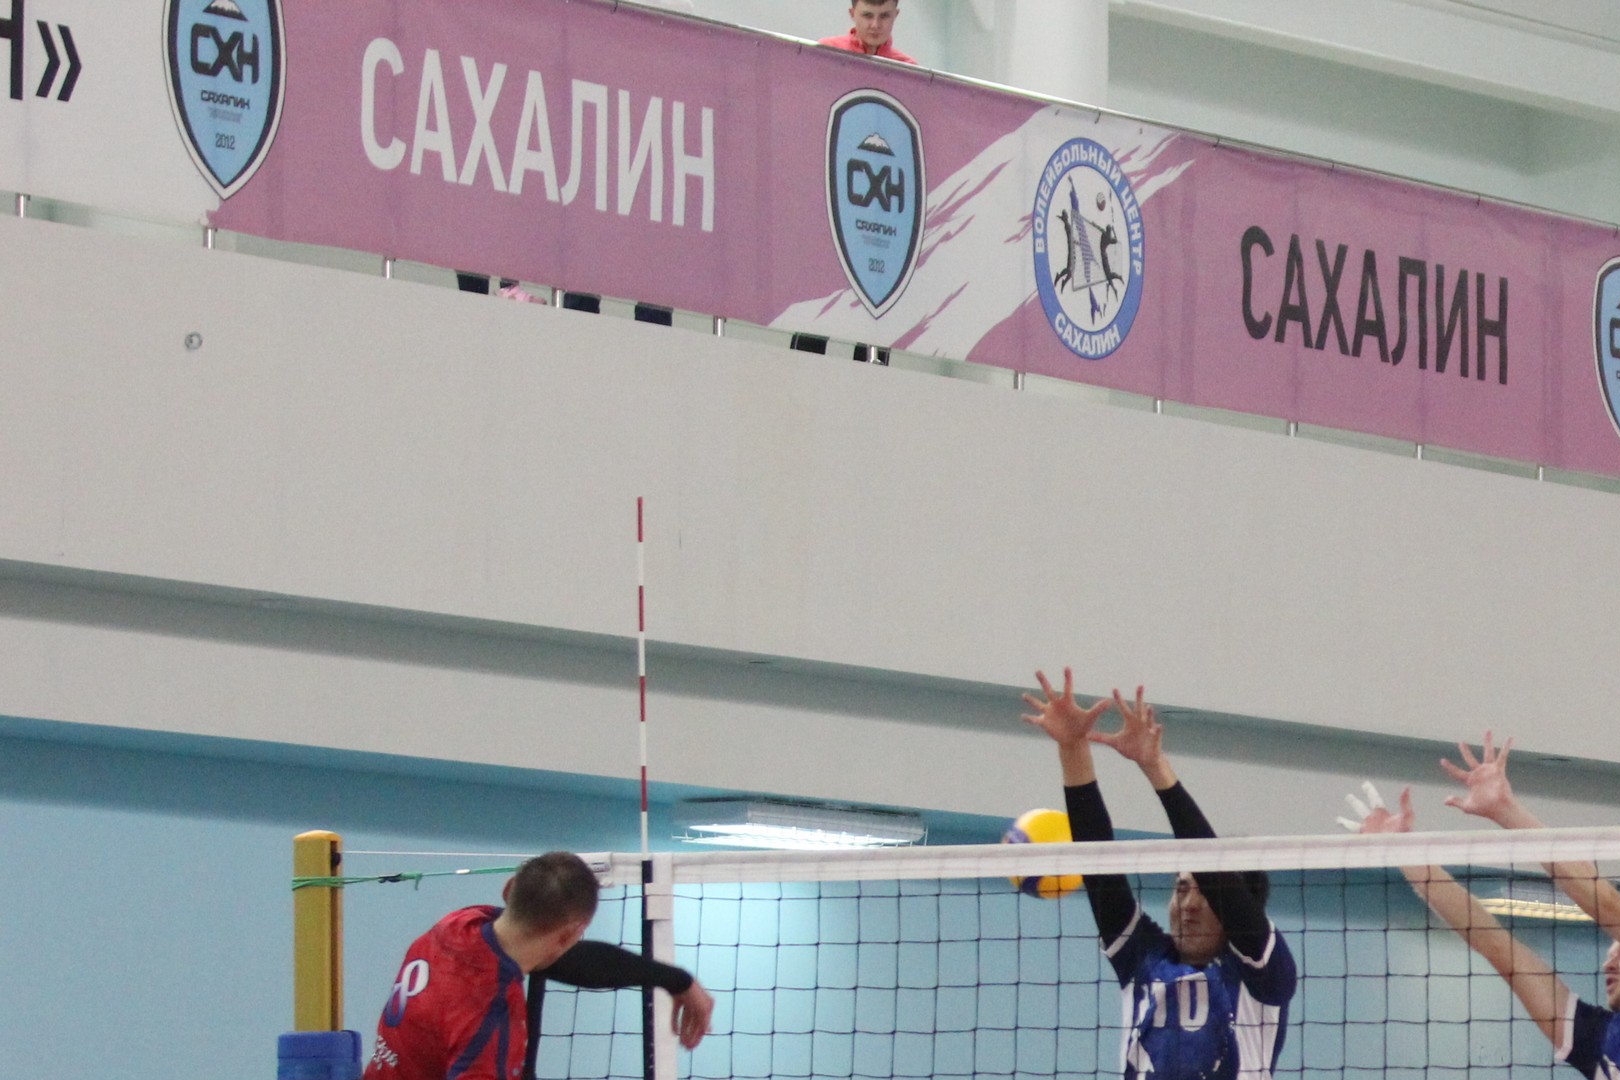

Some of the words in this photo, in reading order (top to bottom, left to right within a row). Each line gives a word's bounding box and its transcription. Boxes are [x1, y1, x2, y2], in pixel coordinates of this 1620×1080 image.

[215, 133, 235, 150] 2012
[361, 37, 714, 233] САХАЛИН
[1034, 144, 1121, 253] ВОЛЕЙБОЛЬНЫЙ
[1120, 188, 1143, 276] ЦЕНТР
[1054, 312, 1121, 356] САХАЛИН
[1240, 225, 1509, 385] САХАЛИН
[1150, 972, 1210, 1031] 10
